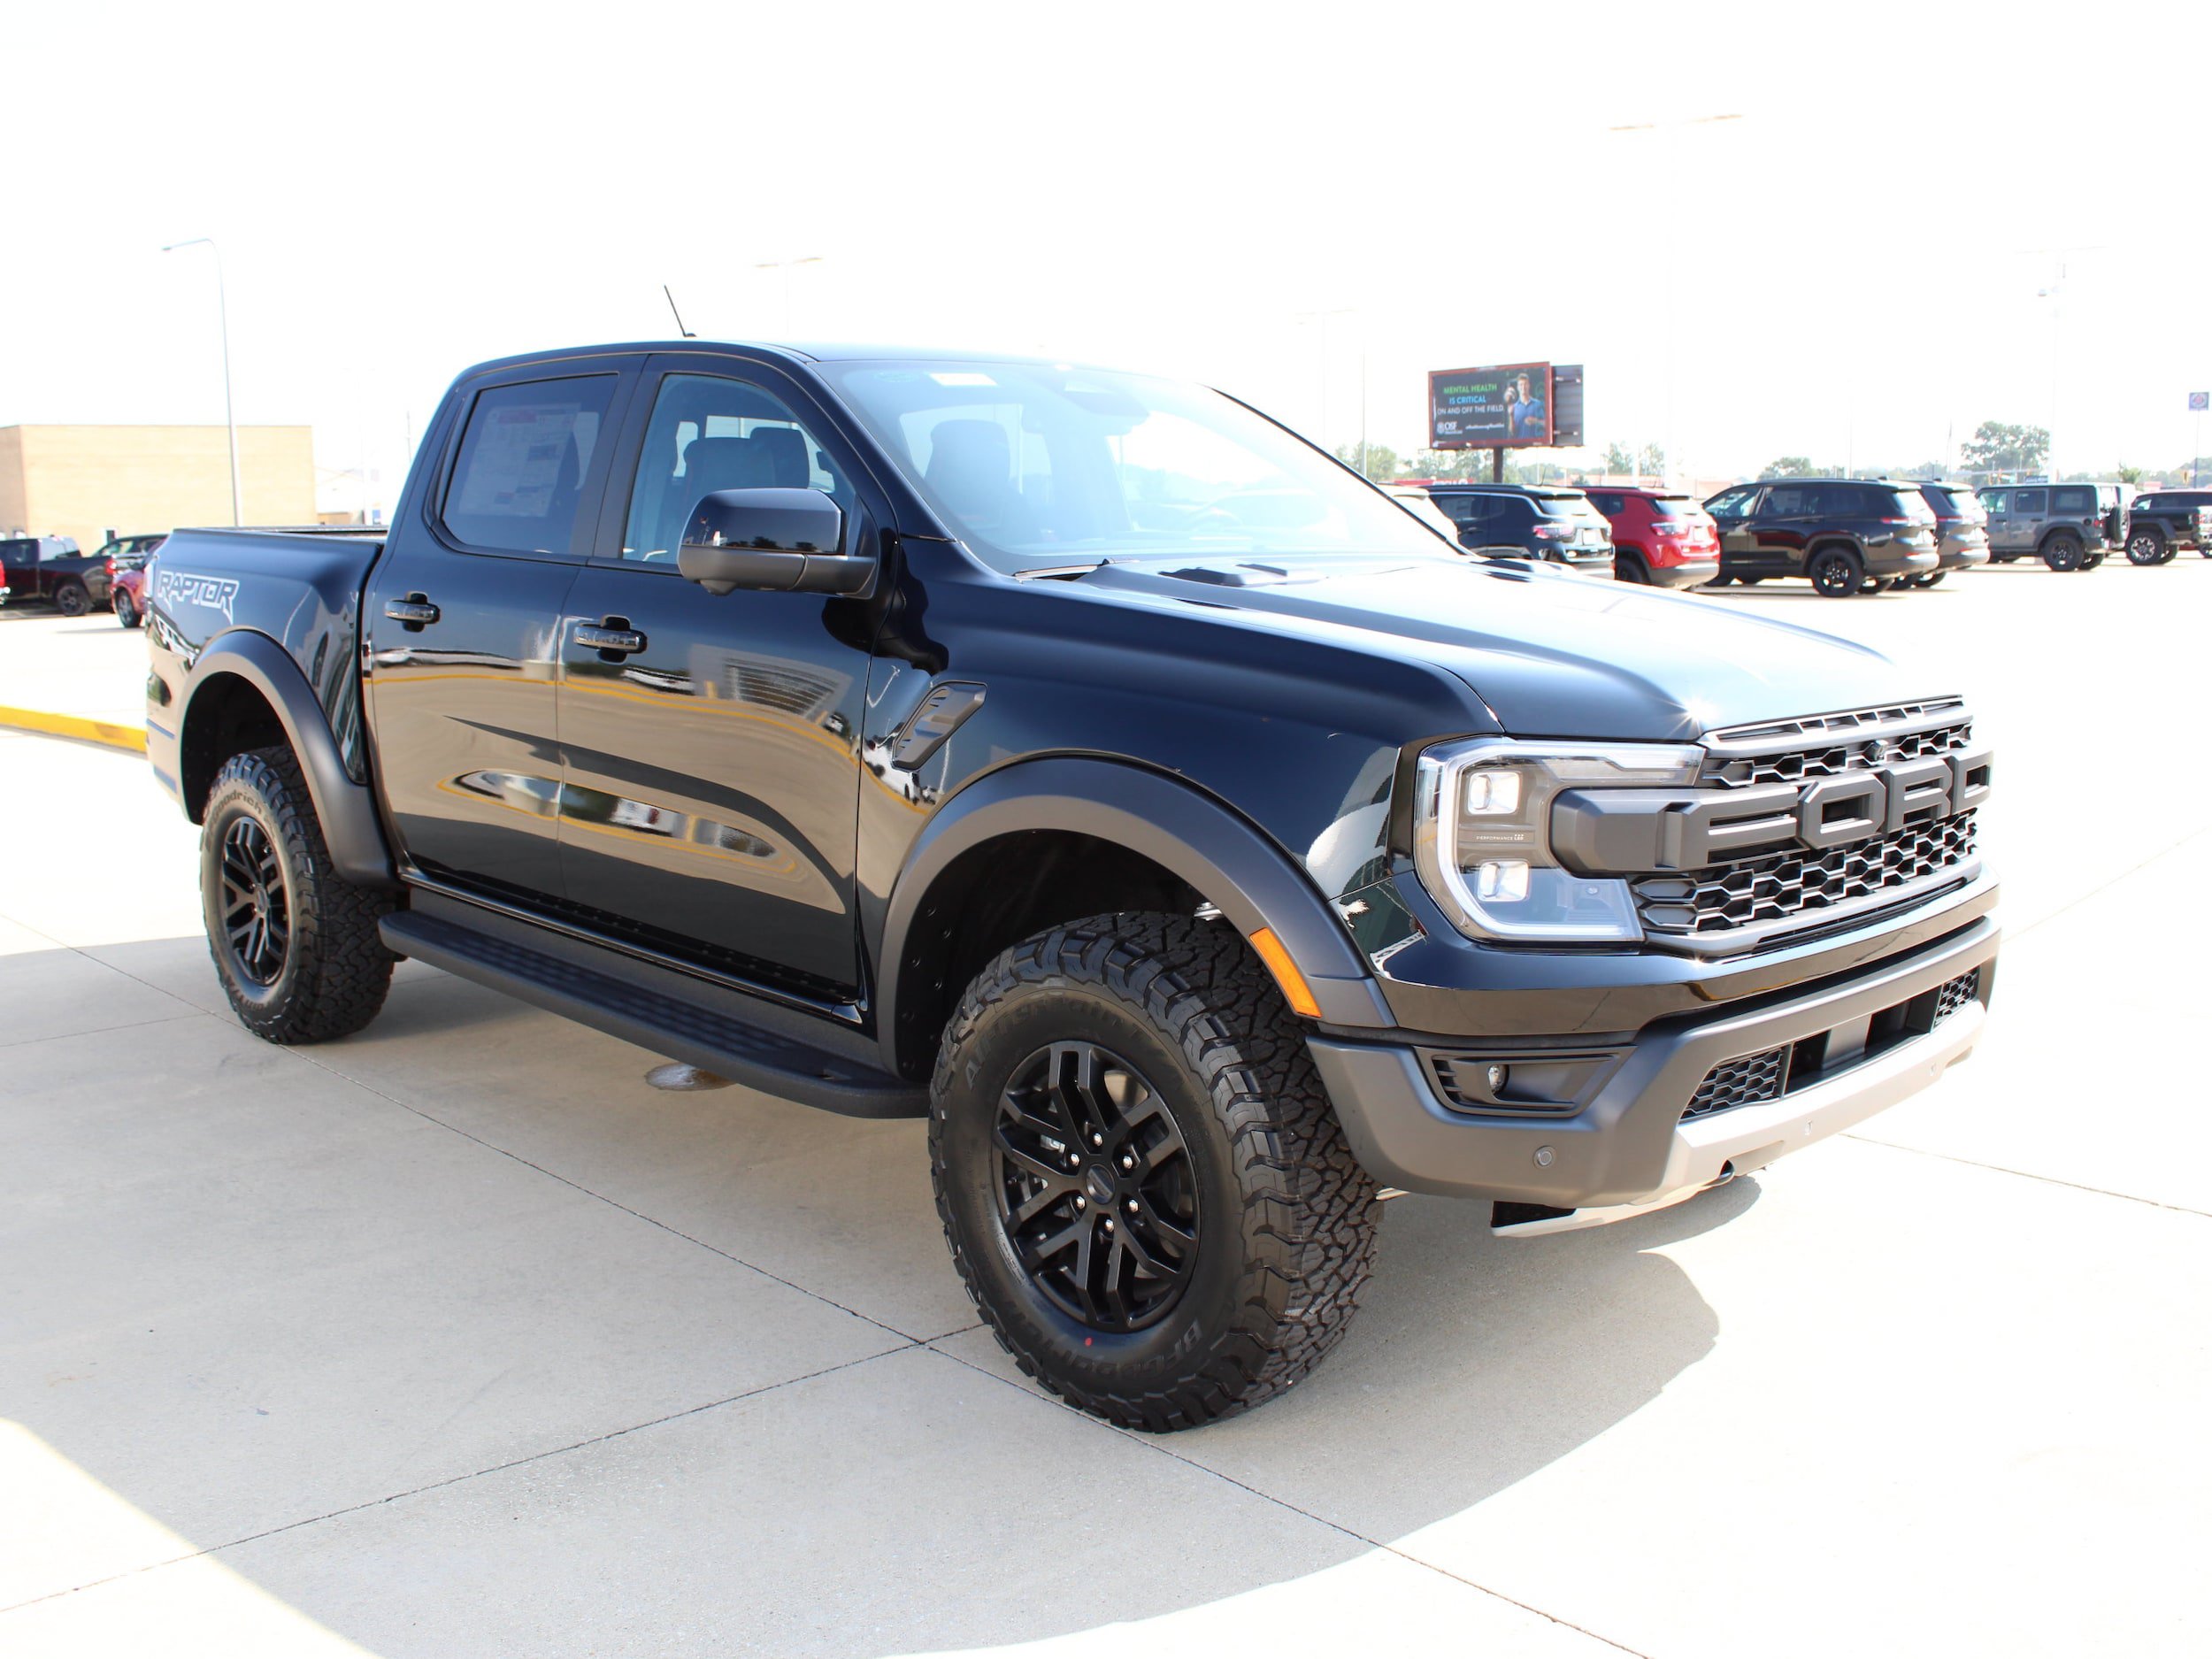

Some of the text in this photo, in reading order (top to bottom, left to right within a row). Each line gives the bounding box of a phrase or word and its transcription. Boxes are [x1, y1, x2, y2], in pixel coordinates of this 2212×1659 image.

[1443, 383, 1497, 395] MENTAL HEALTH
[1456, 395, 1486, 404] CRITICAL
[1462, 405, 1472, 414] OFF
[1474, 404, 1486, 413] THE
[1486, 403, 1504, 413] FIELD
[157, 570, 240, 626] RAPTOR
[1658, 749, 1993, 872] FORD
